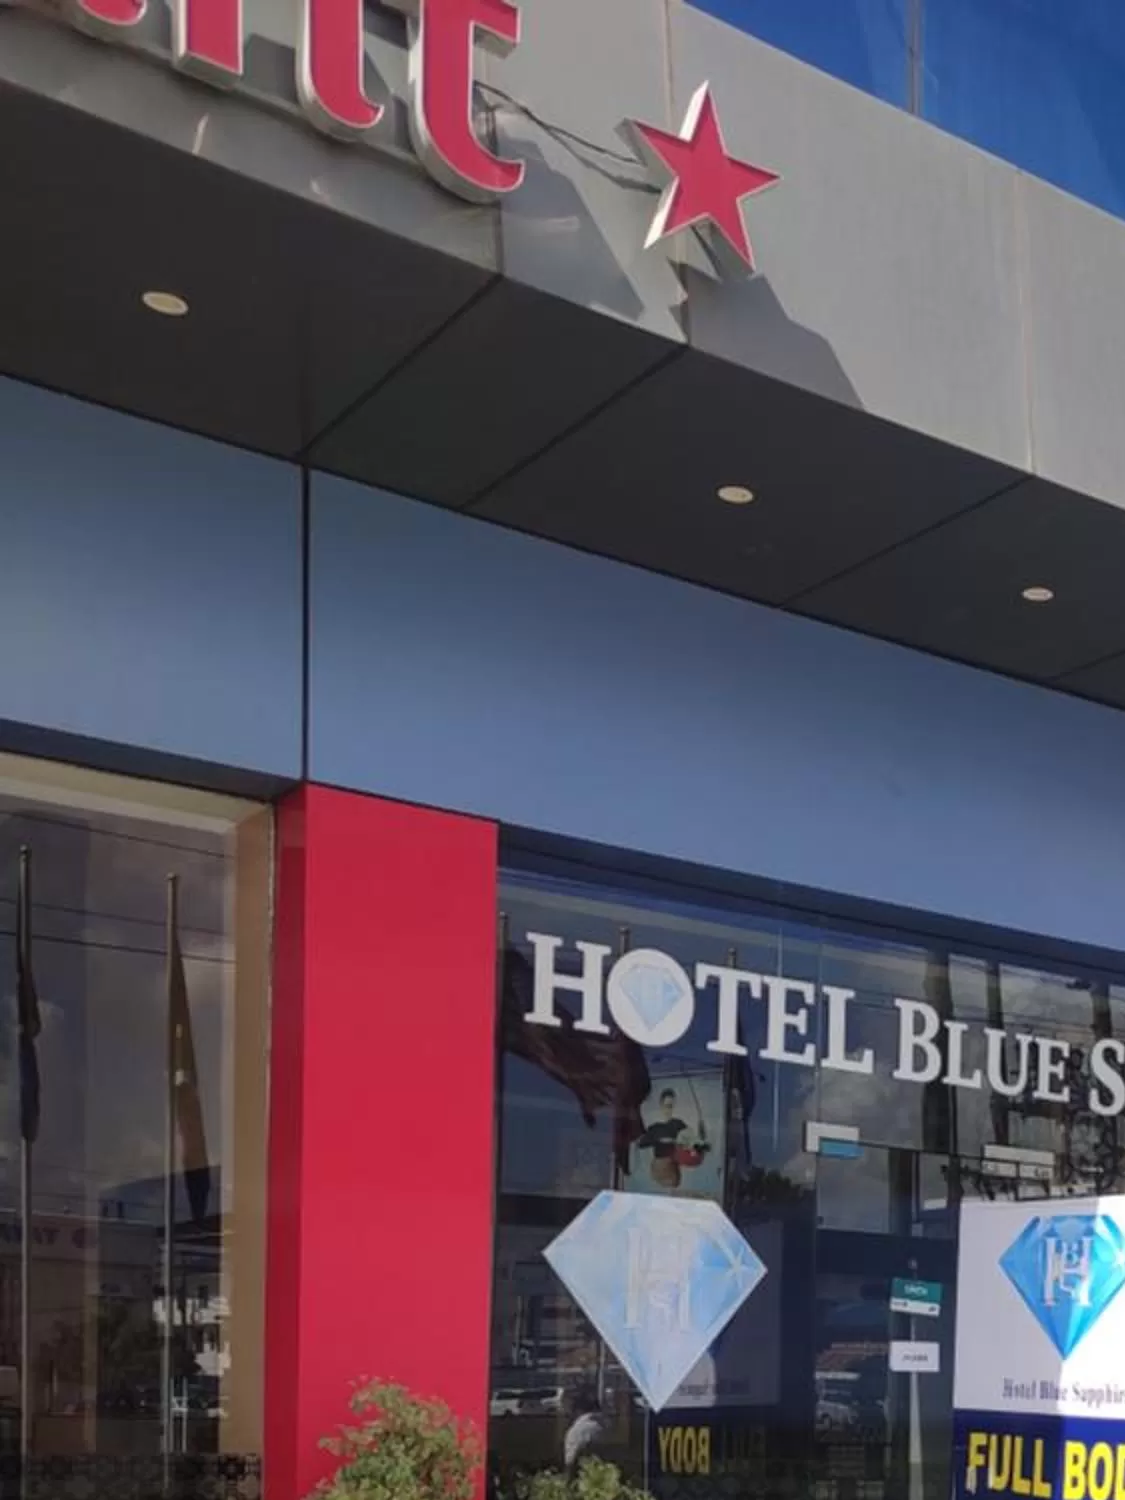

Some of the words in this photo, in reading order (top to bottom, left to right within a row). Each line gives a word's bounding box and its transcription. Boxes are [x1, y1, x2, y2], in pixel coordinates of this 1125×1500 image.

[524, 931, 873, 1074] HOTEL
[892, 998, 1070, 1102] BLUE
[964, 1432, 1052, 1499] FULL
